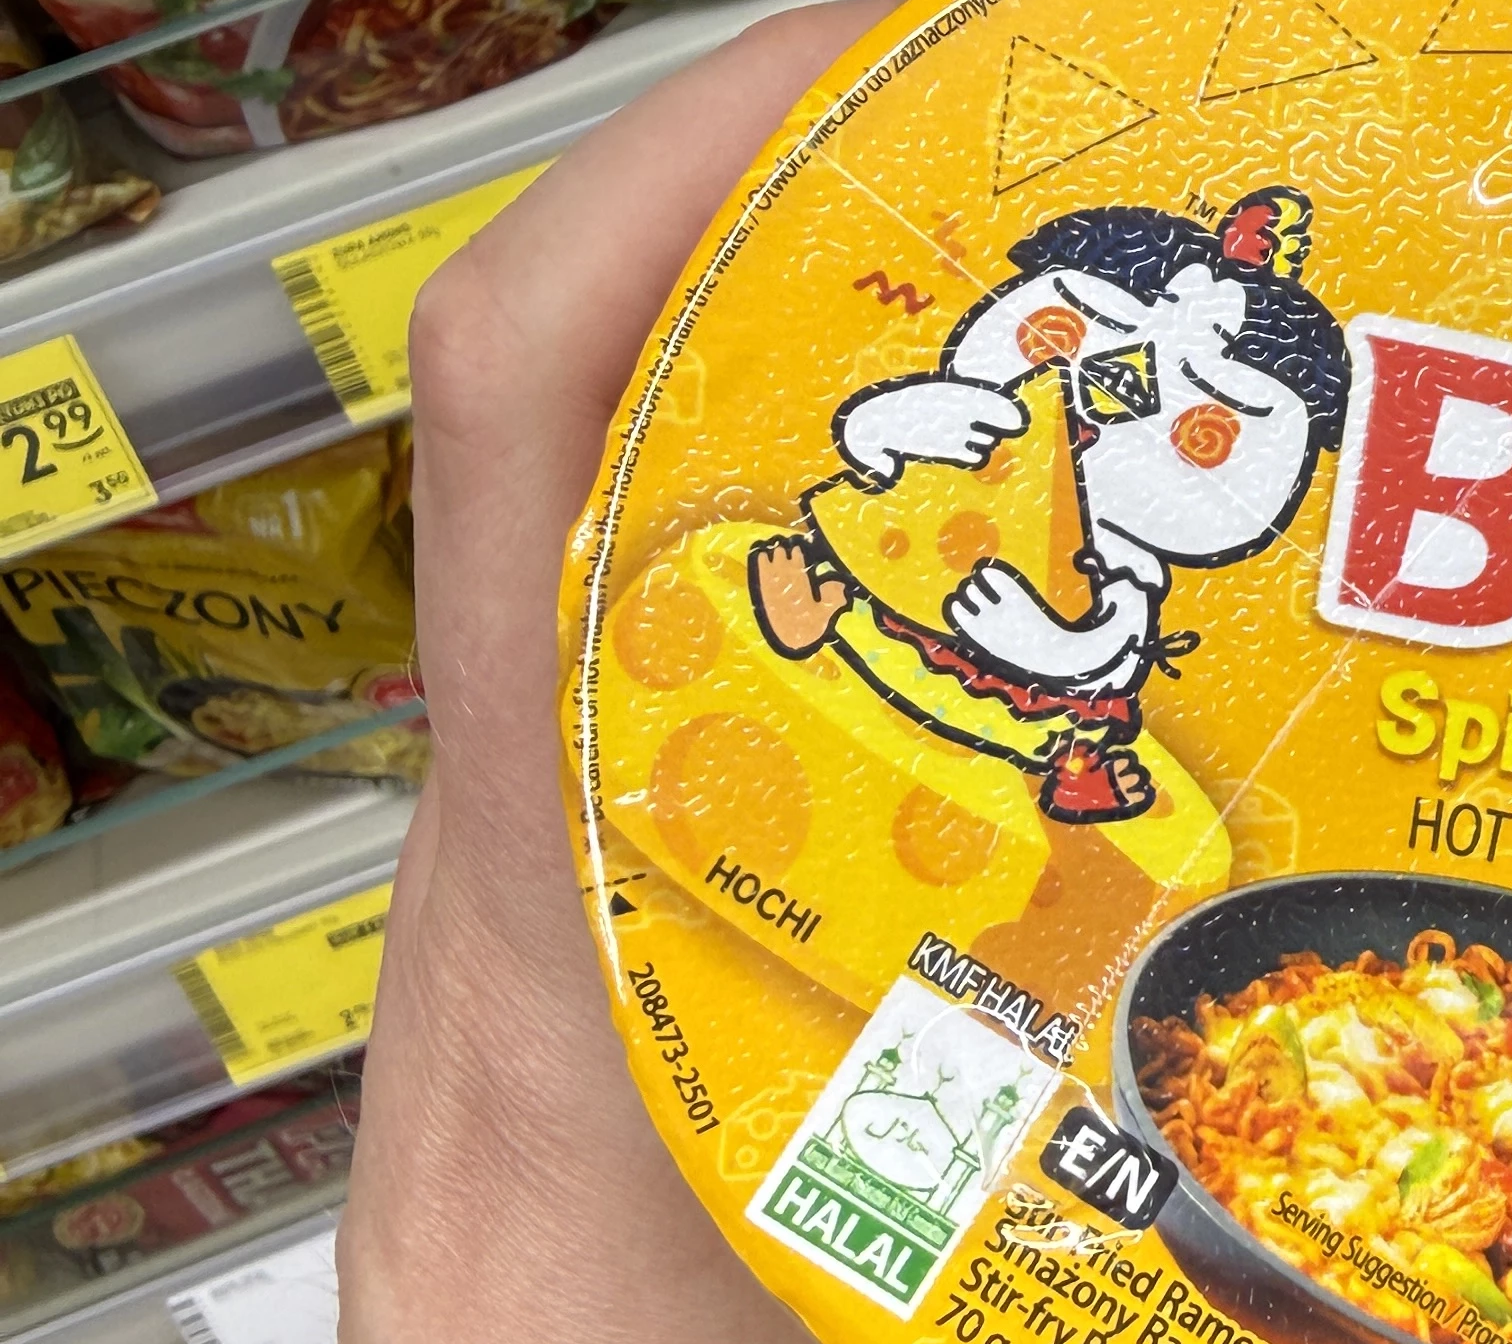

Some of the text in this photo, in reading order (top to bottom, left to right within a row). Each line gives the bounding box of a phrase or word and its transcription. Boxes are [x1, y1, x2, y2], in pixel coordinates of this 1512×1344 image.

[863, 65, 892, 93] do
[806, 87, 868, 150] wieczko
[685, 272, 718, 308] the
[658, 306, 701, 358] drain
[620, 380, 664, 444] below
[602, 446, 641, 499] holes
[1, 567, 347, 642] PIECZONY
[705, 855, 822, 944] HOCHI
[628, 962, 720, 1135] 208473-2501
[1059, 1125, 1159, 1215] E/N
[773, 1178, 912, 1294] HALAL
[1272, 1190, 1346, 1257] Serving
[1342, 1237, 1446, 1318] Suggestion
[984, 1217, 1139, 1338] Smażony
[936, 1295, 985, 1342] 70
